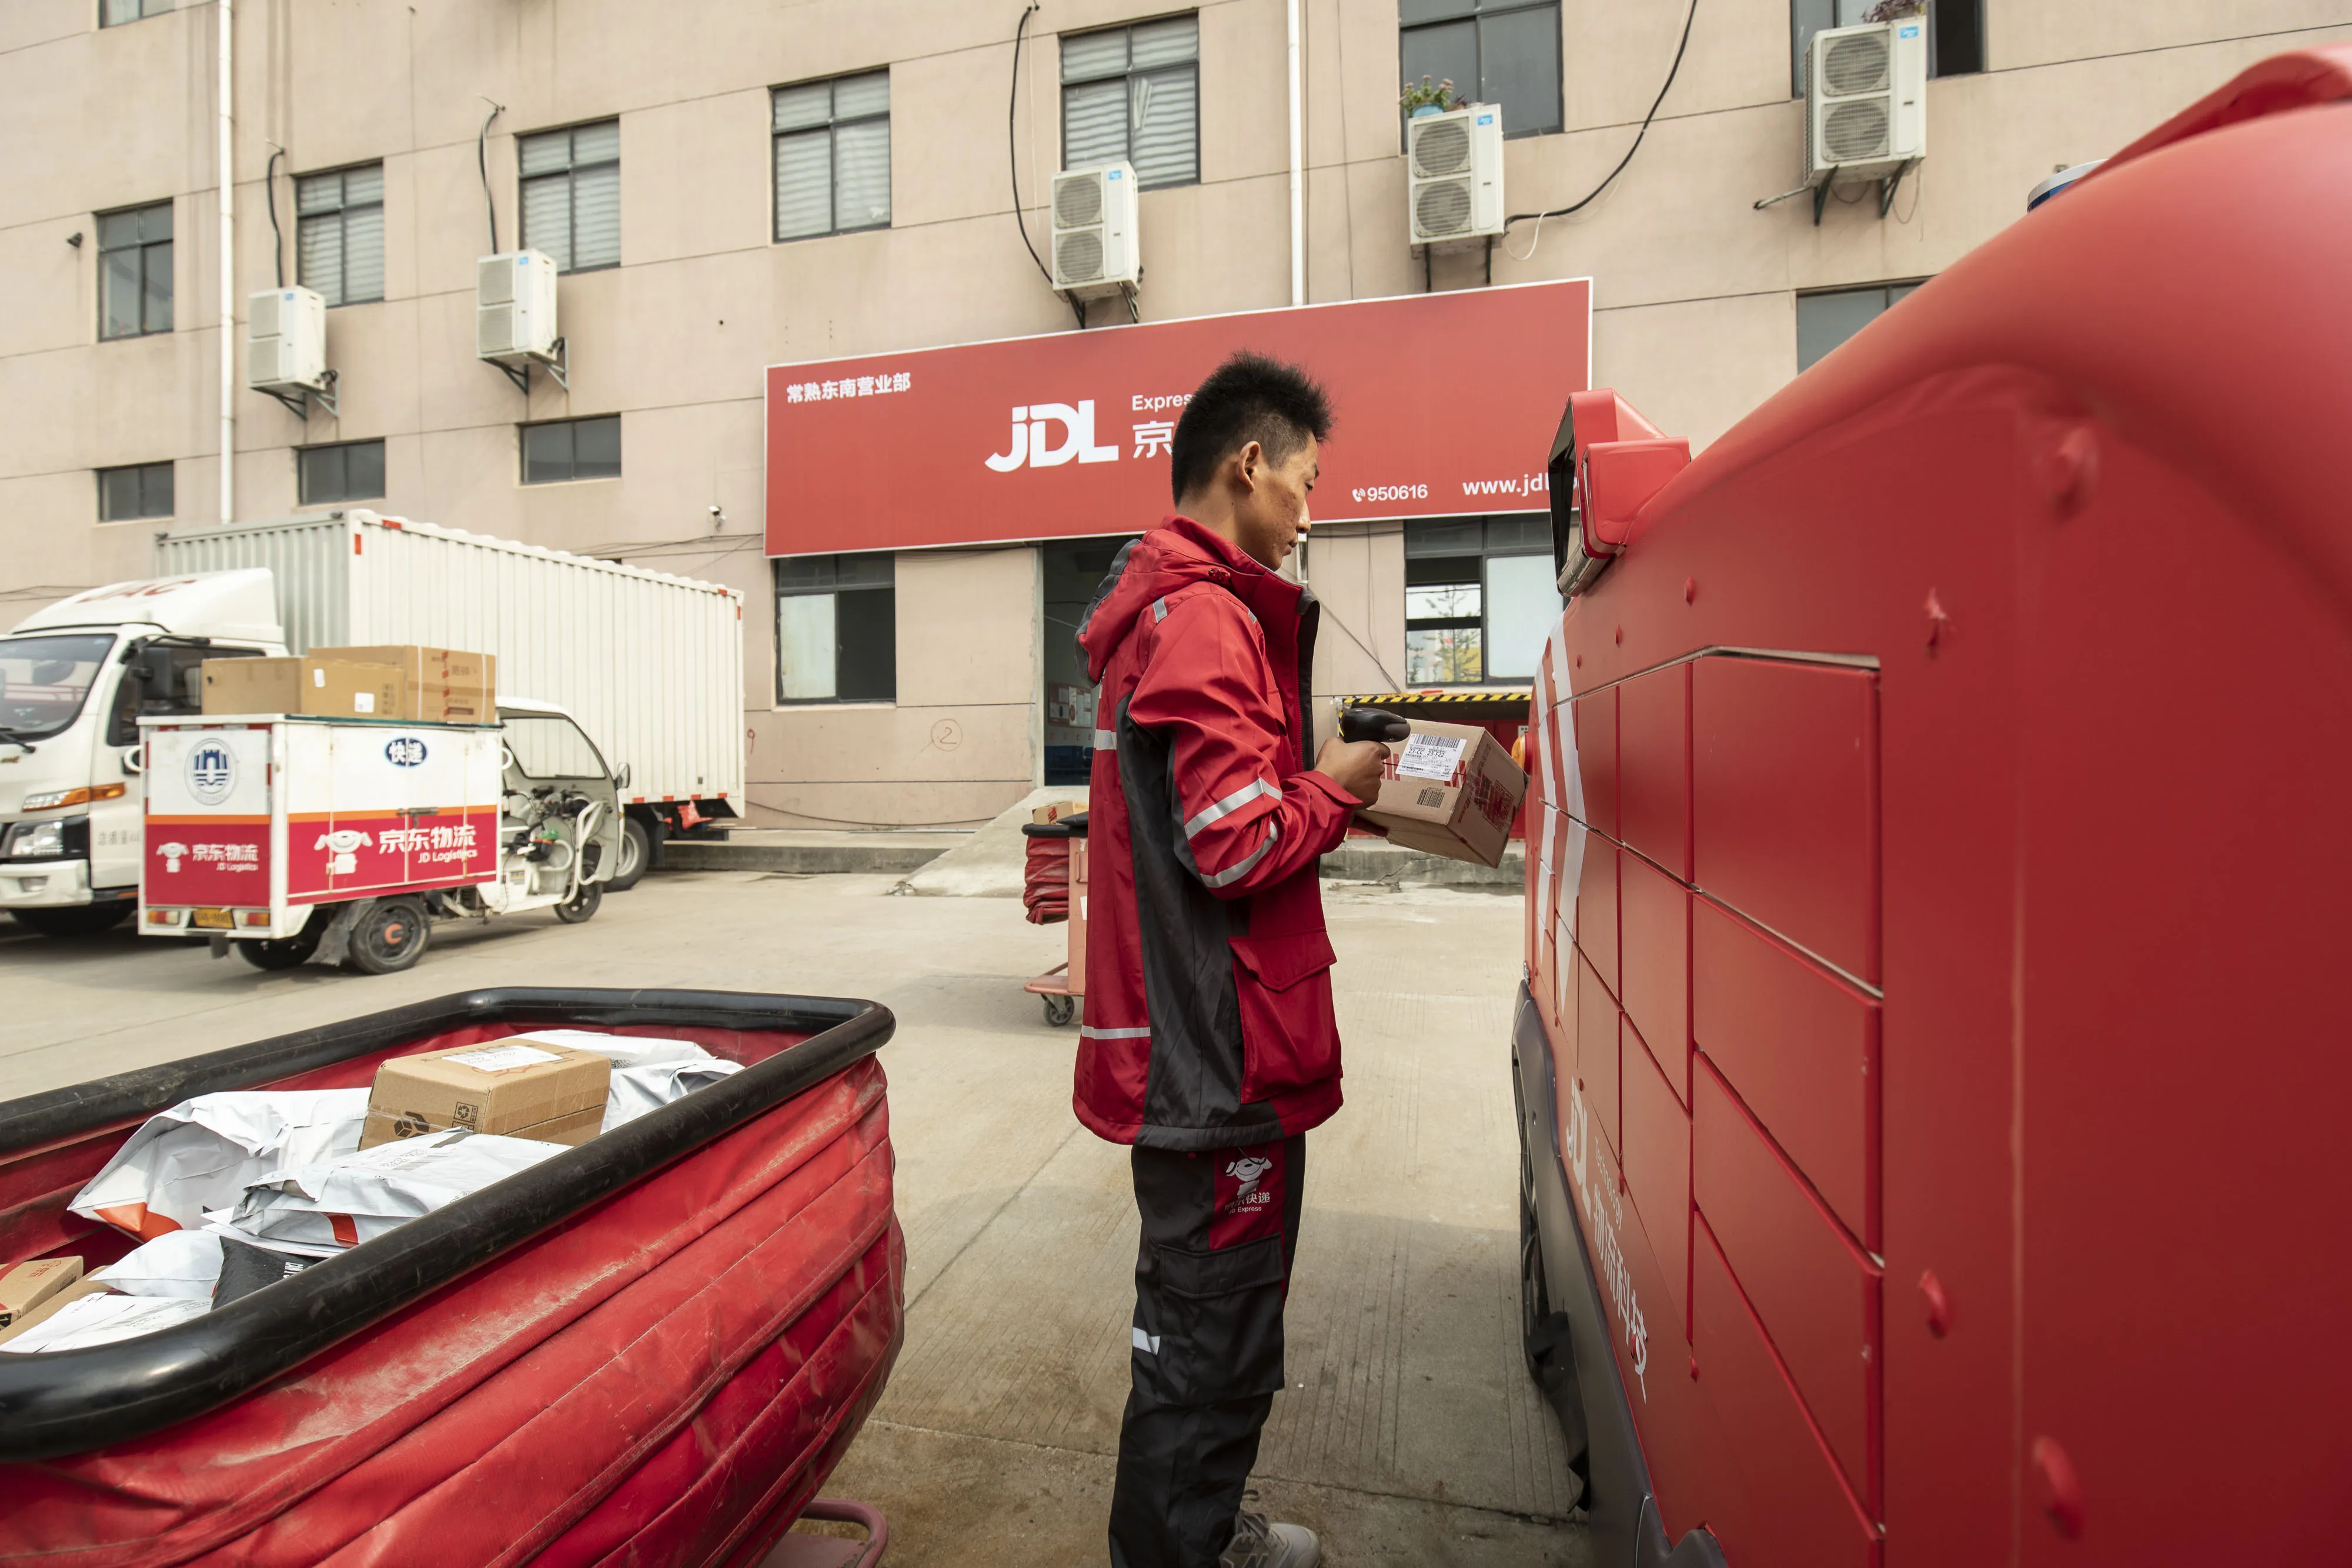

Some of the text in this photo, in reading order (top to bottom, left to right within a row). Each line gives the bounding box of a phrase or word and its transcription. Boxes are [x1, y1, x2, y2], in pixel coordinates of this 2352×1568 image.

[787, 372, 911, 403] 常熟东南营业部
[1132, 394, 1195, 413] Expres
[984, 399, 1119, 472] JDL
[1367, 484, 1428, 502] 950616
[1462, 472, 1578, 497] www.jdl
[940, 727, 957, 744] 2
[389, 741, 422, 764] 快递
[379, 824, 476, 854] 京东物流
[192, 844, 259, 861] 京东物流
[418, 850, 478, 863] JD Logistics
[1566, 1076, 1591, 1222] JDL
[1595, 1136, 1623, 1231] Technology
[1594, 1183, 1646, 1405] 物流科技
